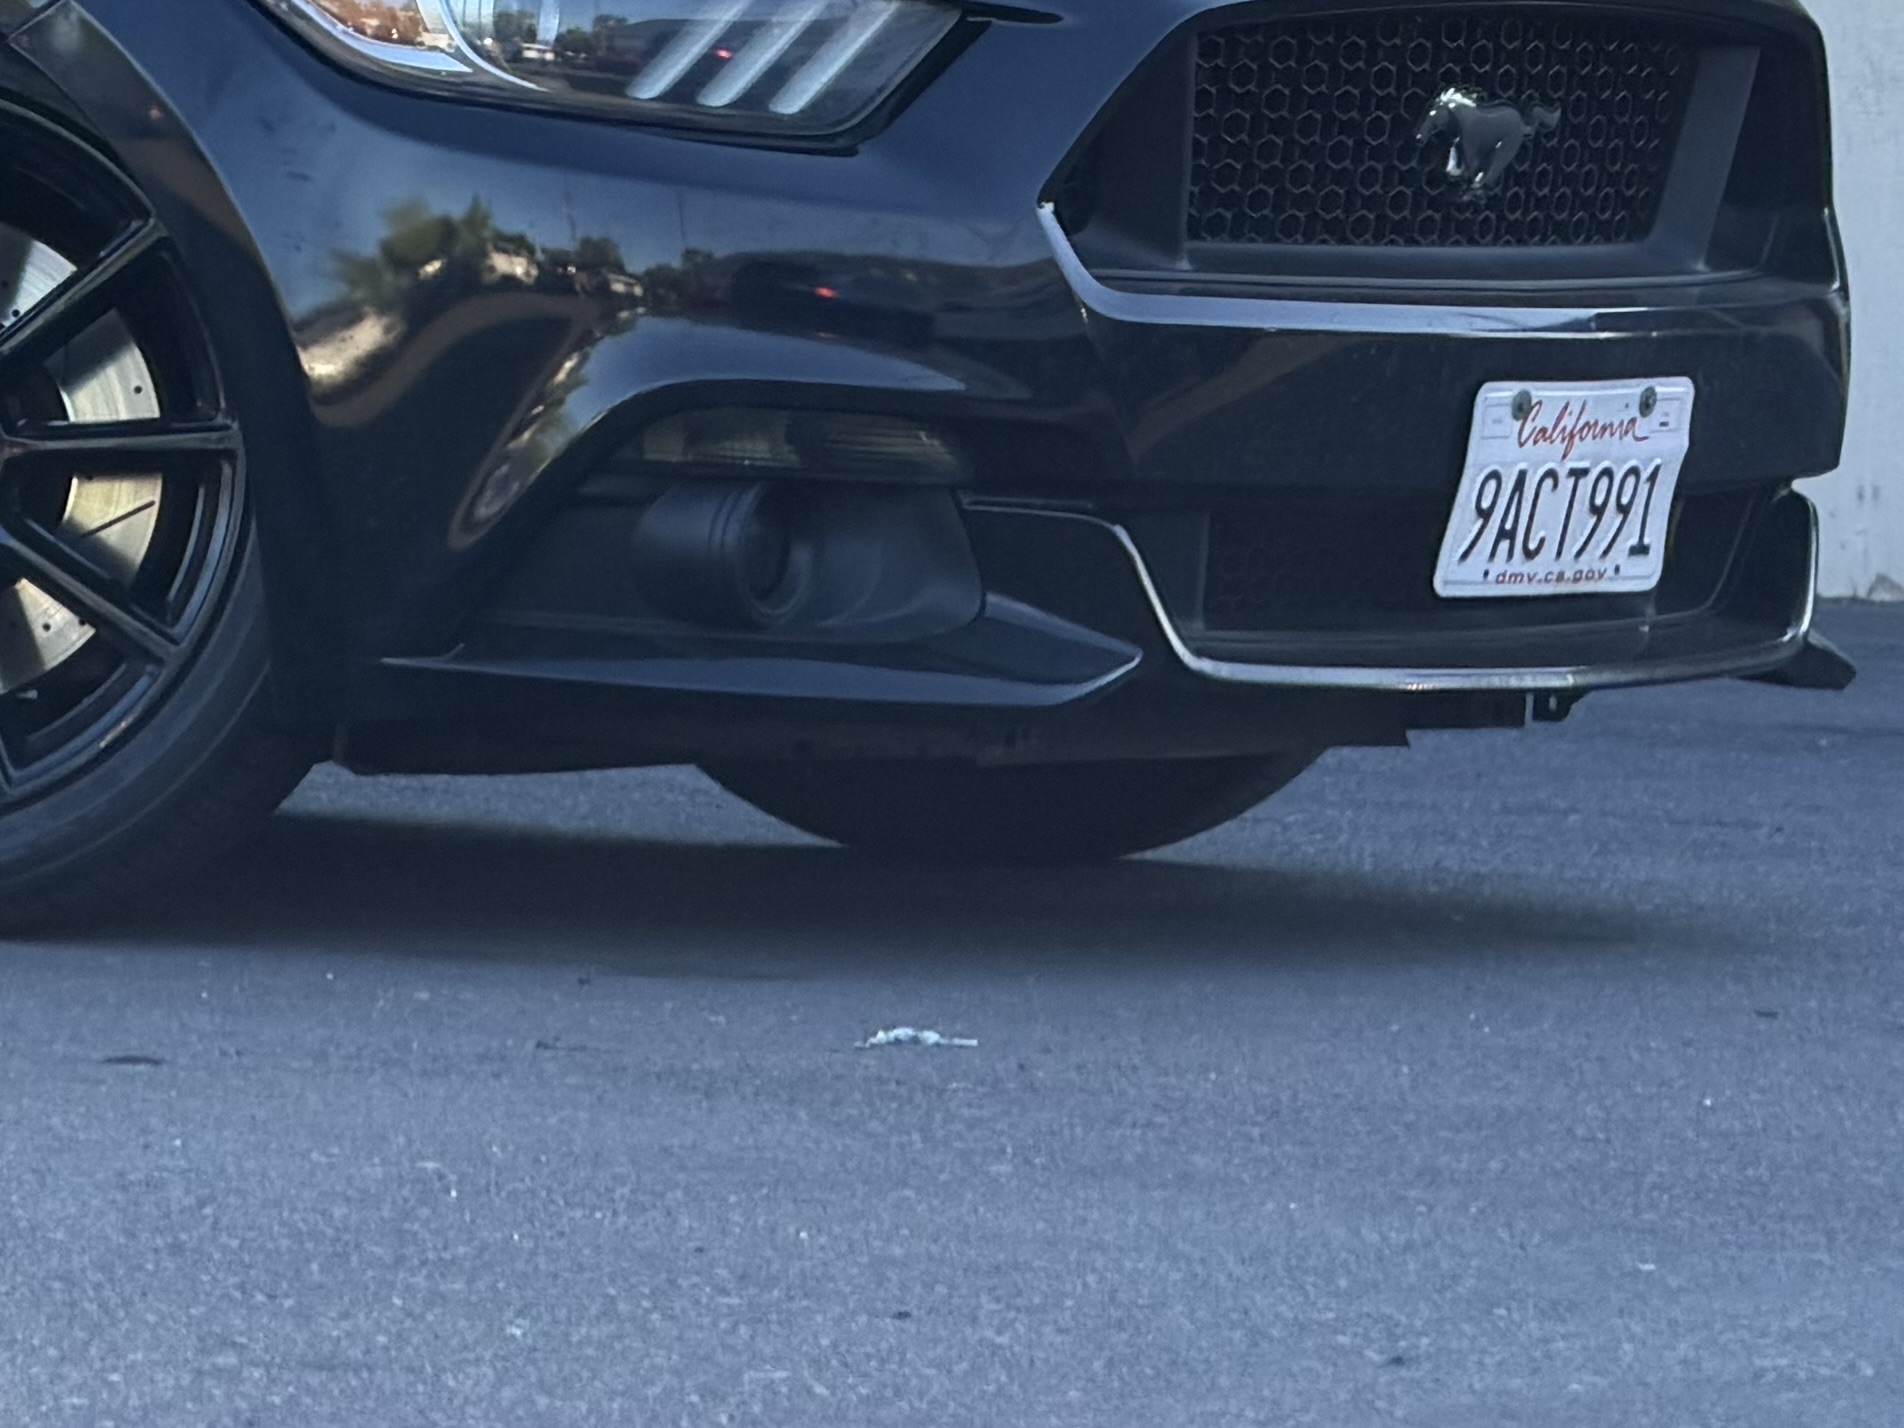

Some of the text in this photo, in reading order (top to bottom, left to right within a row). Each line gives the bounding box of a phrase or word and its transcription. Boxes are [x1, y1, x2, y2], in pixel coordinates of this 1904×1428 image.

[1517, 399, 1650, 461] California
[1457, 459, 1662, 564] 9ACT991
[1495, 567, 1607, 585] dmv.ca.gov
